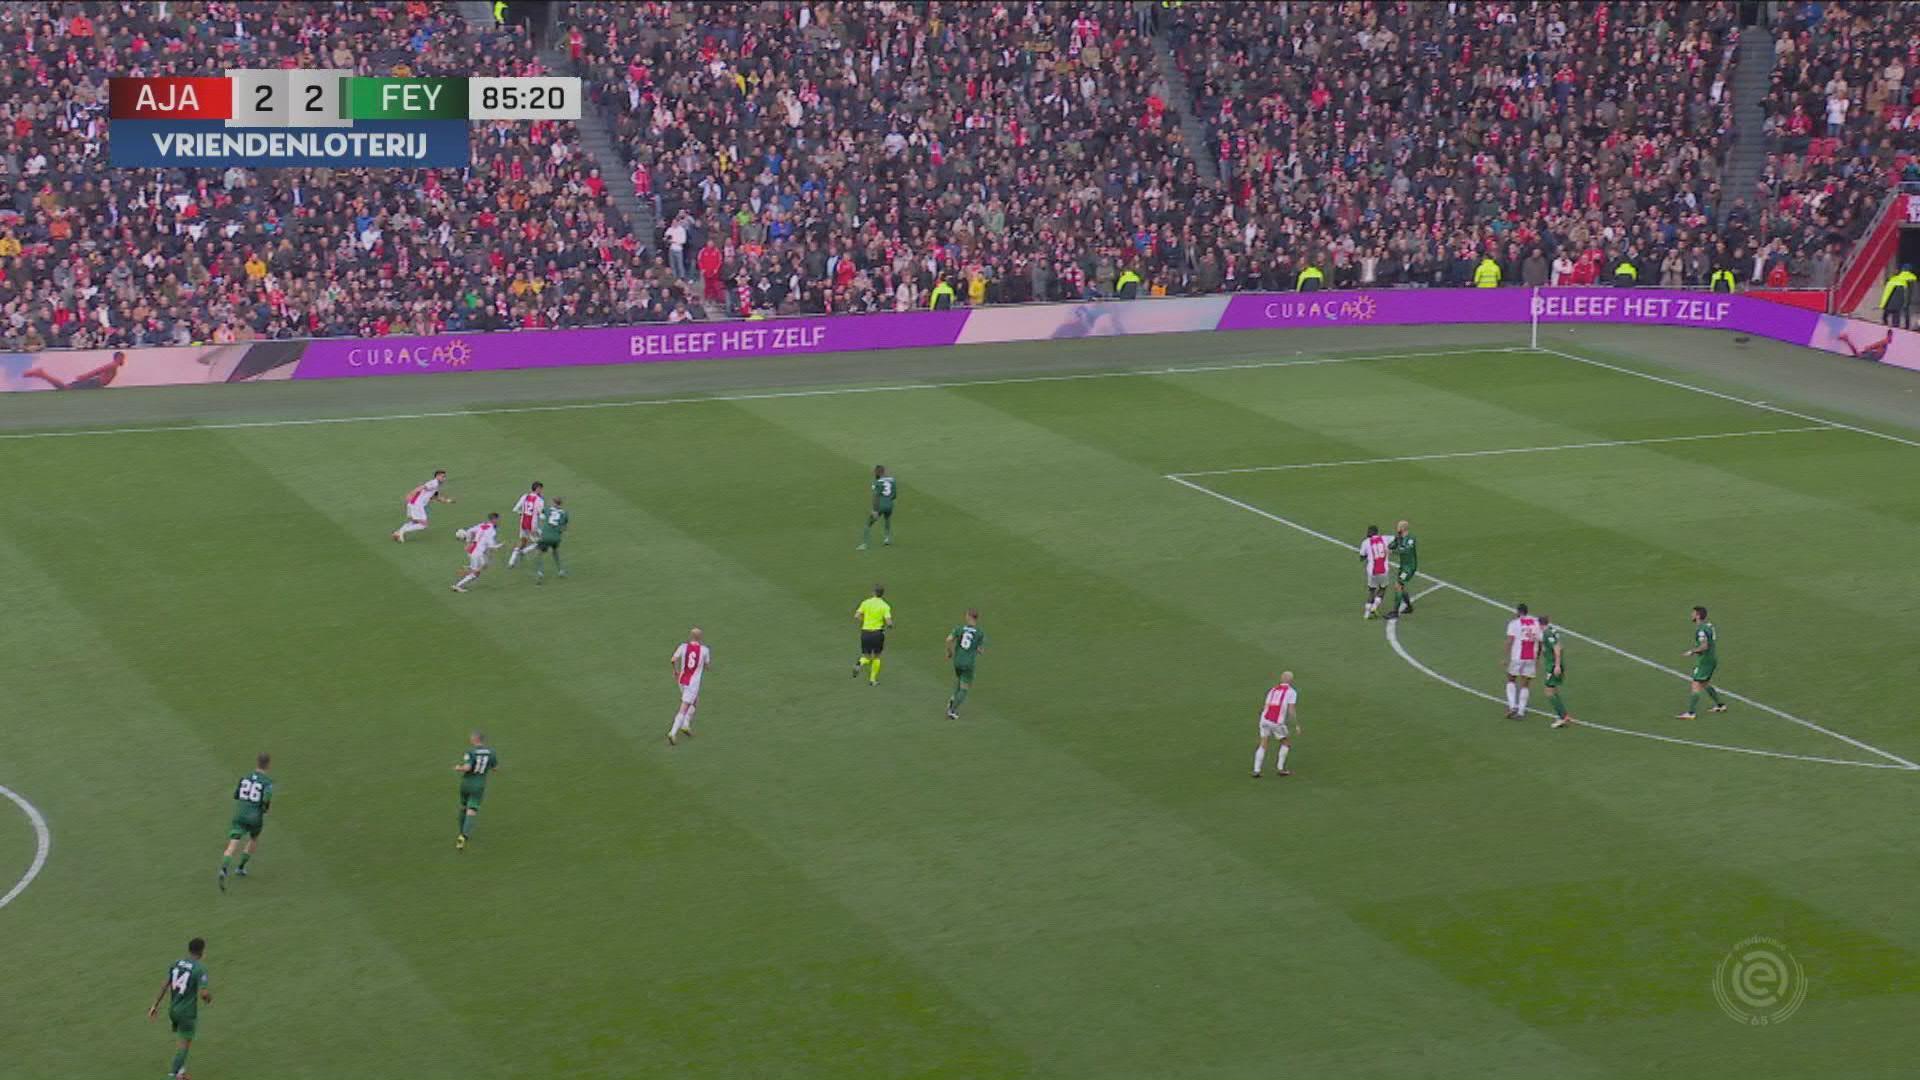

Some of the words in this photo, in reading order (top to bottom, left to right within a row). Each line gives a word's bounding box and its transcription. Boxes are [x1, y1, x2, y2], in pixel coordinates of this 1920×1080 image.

[1530, 296, 1618, 317] BELEEF
[1623, 298, 1673, 318] HET
[1675, 300, 1732, 322] ZELF
[630, 332, 717, 356] BELEEF
[721, 329, 769, 351] HET
[772, 326, 827, 349] ZELF
[882, 480, 892, 497] 3
[548, 510, 561, 526] 2
[960, 631, 974, 650] 6
[687, 651, 697, 669] 6
[474, 754, 489, 774] 11
[239, 779, 263, 802] 26
[172, 967, 191, 995] 14
